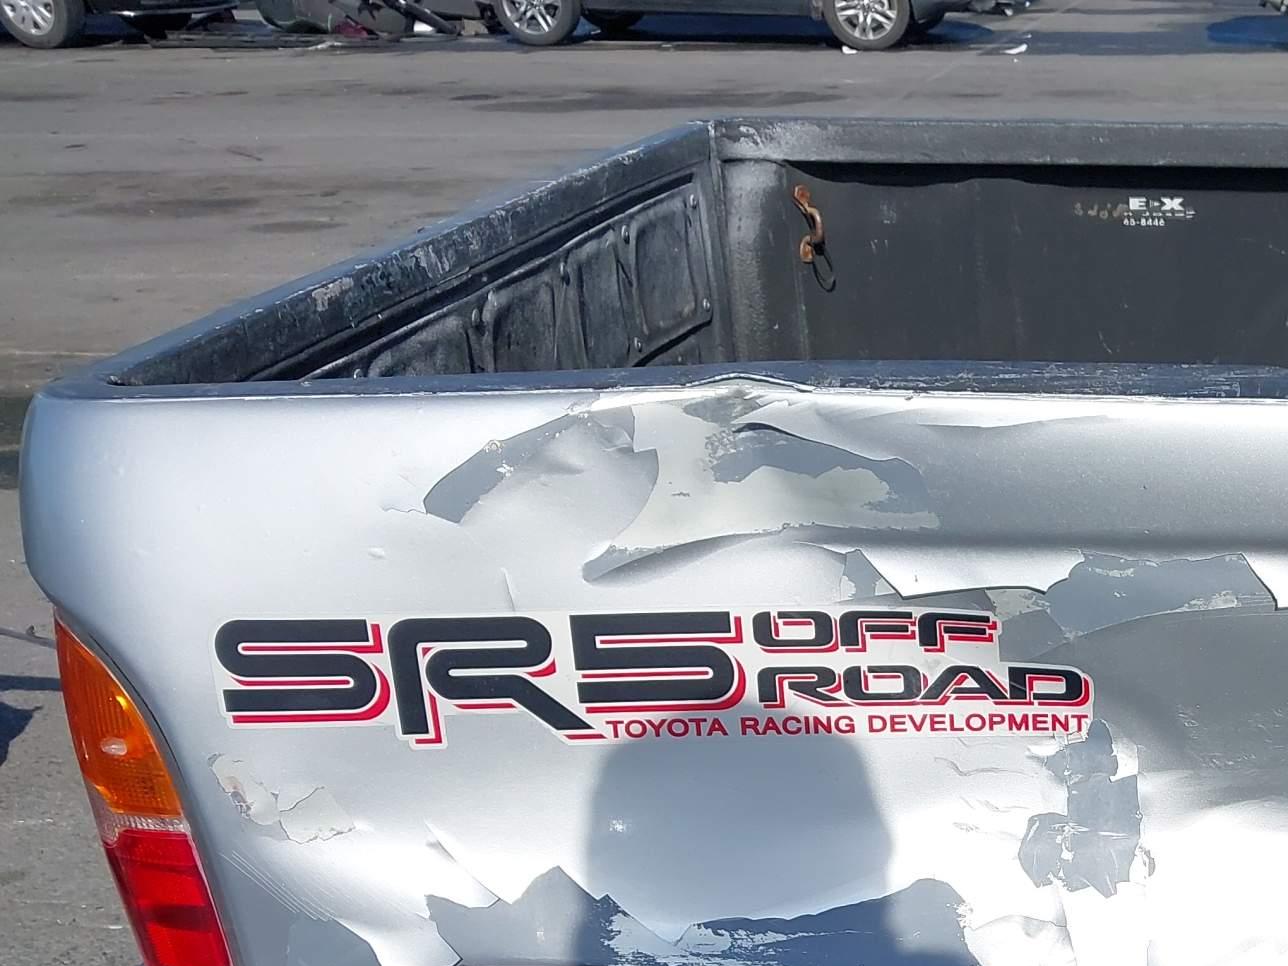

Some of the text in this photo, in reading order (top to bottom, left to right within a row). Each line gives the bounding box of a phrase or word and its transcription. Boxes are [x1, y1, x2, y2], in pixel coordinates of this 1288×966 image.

[215, 610, 999, 744] SR5 OFF
[757, 663, 1093, 710] ROAD
[605, 713, 1089, 738] TOYOTA RACING DEVELOPMENT
